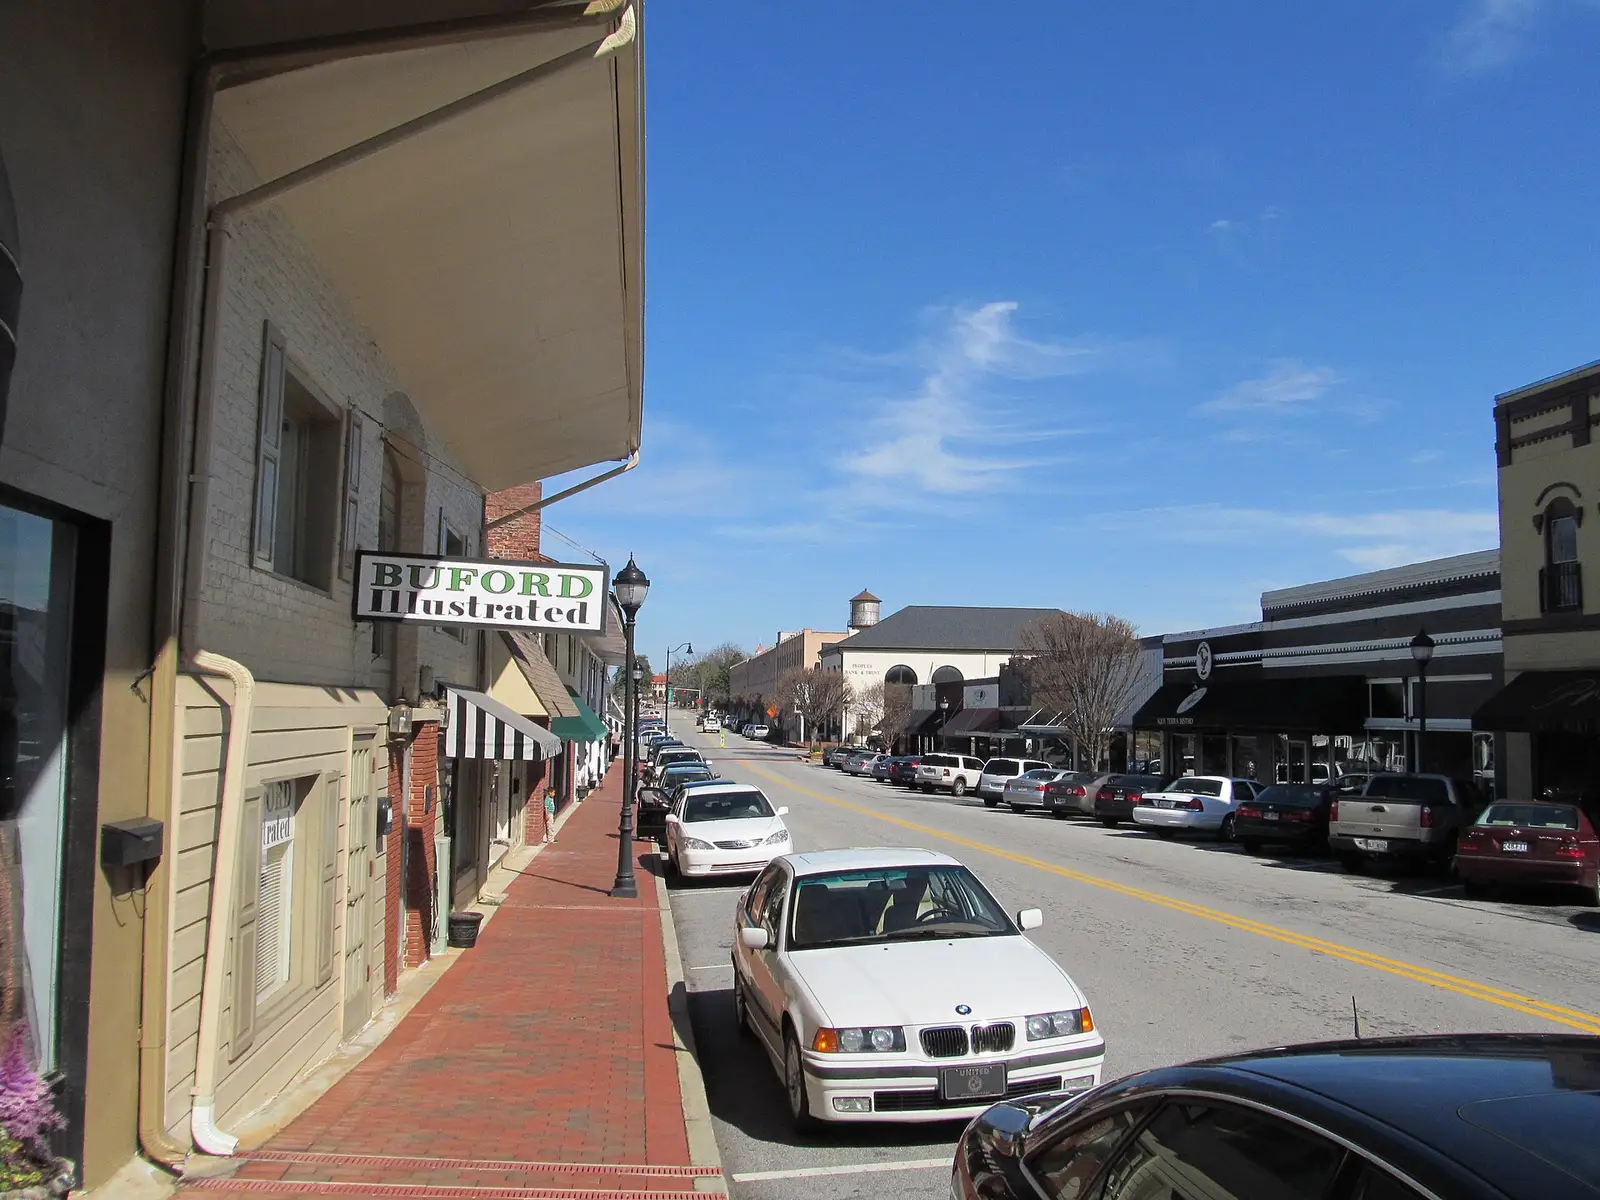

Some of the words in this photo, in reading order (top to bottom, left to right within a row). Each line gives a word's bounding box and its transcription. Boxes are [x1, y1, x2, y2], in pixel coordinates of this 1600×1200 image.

[370, 562, 593, 599] BUFORD
[368, 588, 590, 625] Illustrated
[960, 1068, 989, 1076] UNITED
